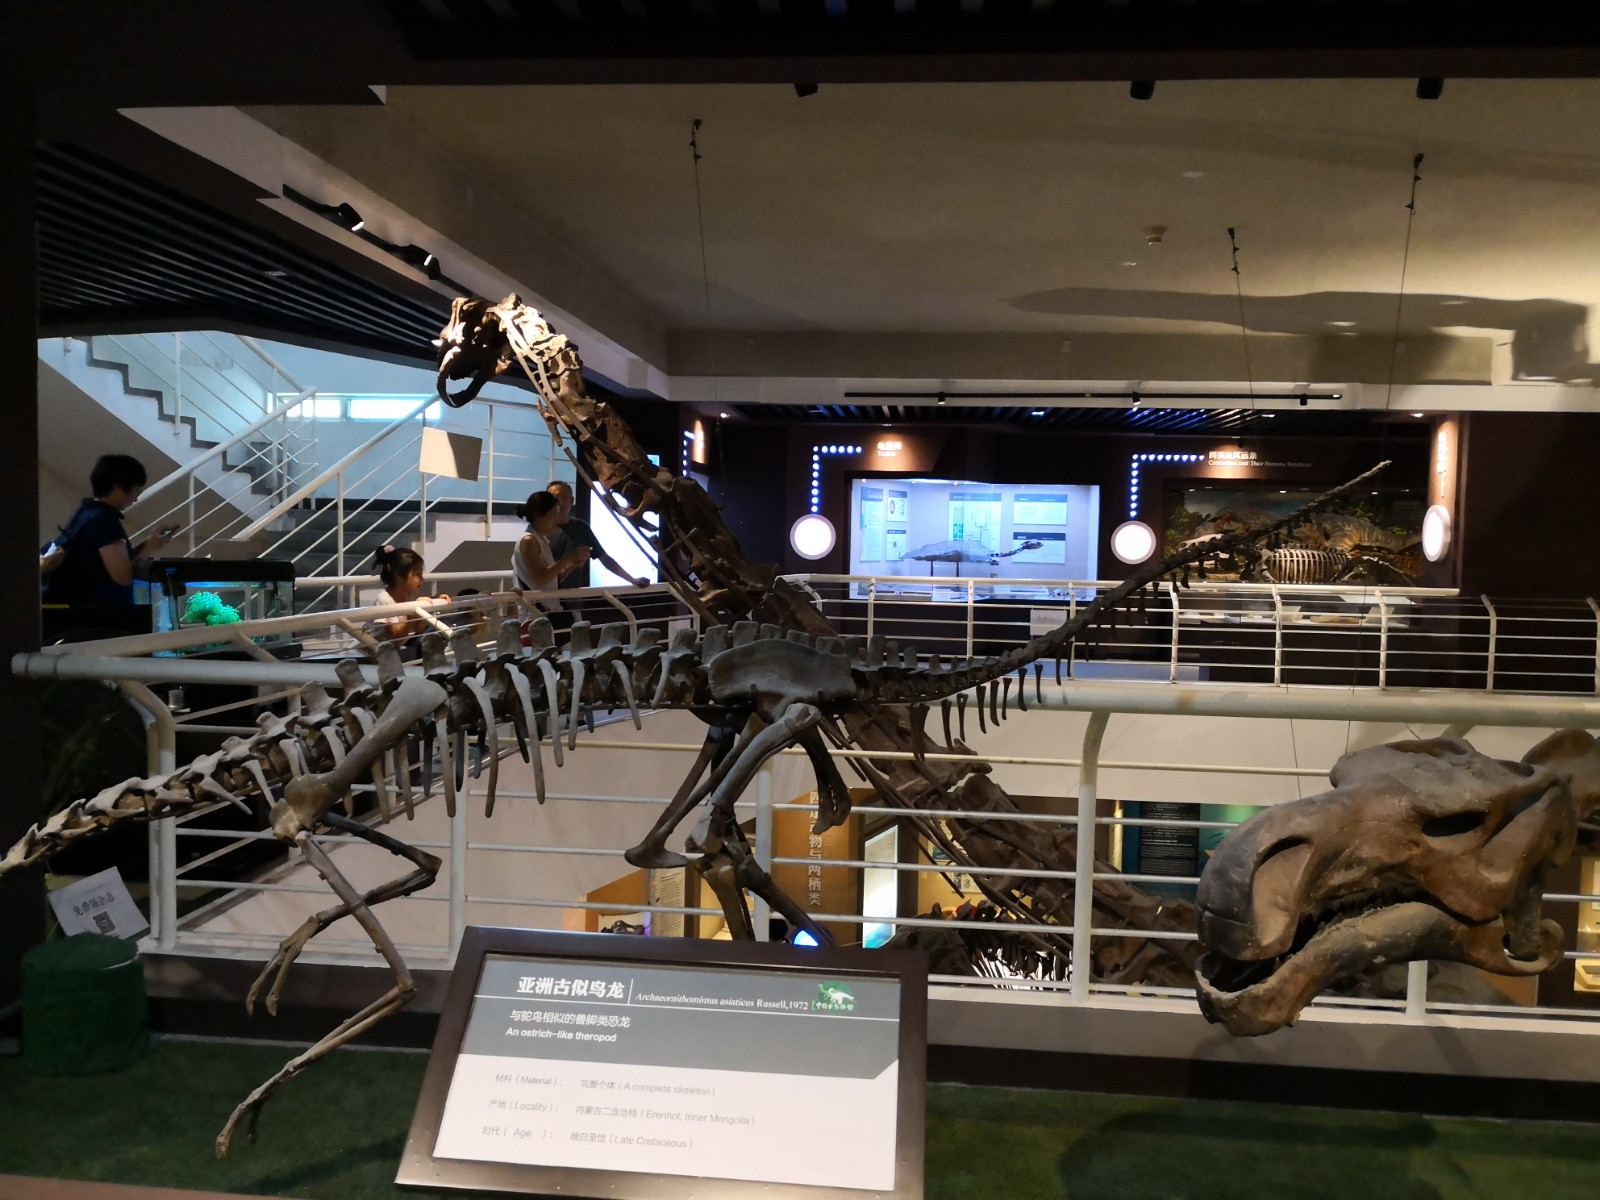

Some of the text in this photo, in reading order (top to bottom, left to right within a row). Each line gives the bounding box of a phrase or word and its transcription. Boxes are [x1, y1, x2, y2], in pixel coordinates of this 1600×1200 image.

[517, 976, 625, 999] 亚洲古似鸟龙
[720, 997, 754, 1007] asiaticus
[510, 1009, 631, 1028] 与鸵鸟相似的兽脚类恐龙
[506, 1027, 617, 1043] An ostrich-like theropod
[632, 1083, 672, 1093] complete
[685, 1112, 708, 1122] Inner
[513, 1128, 532, 1139] Age
